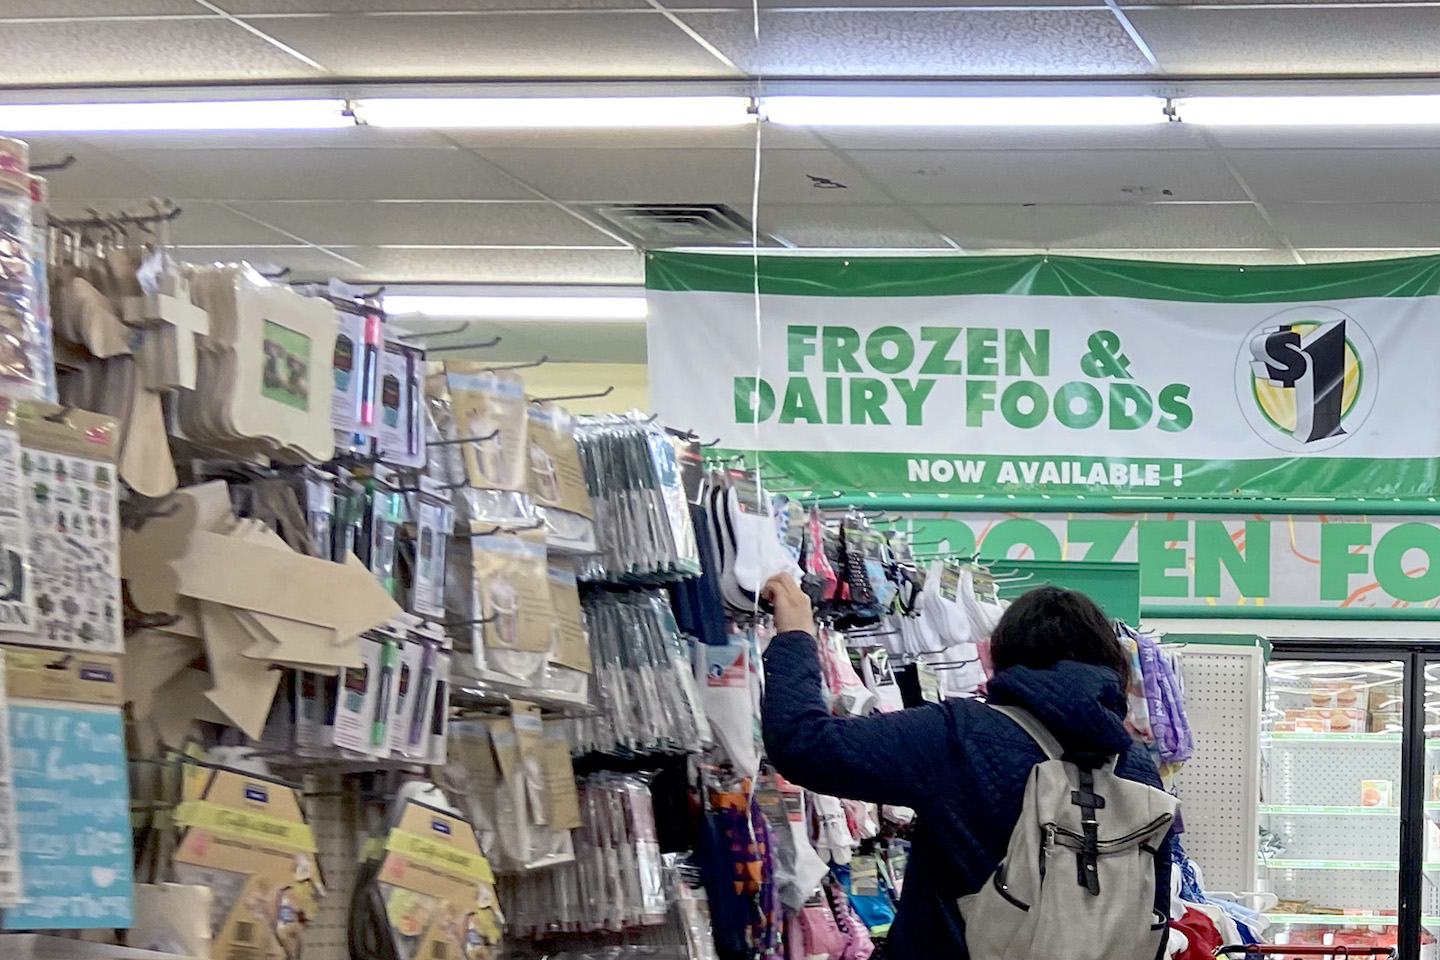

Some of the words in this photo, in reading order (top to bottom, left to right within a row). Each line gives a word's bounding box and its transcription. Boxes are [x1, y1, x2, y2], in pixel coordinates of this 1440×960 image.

[787, 325, 1050, 378] FROZEN
[1081, 329, 1133, 379] &
[733, 376, 936, 430] DAIRY
[965, 378, 1194, 432] FOODS
[907, 459, 990, 483] NOW
[996, 460, 1162, 487] AVAILABLE
[876, 517, 1271, 598] ROZEN
